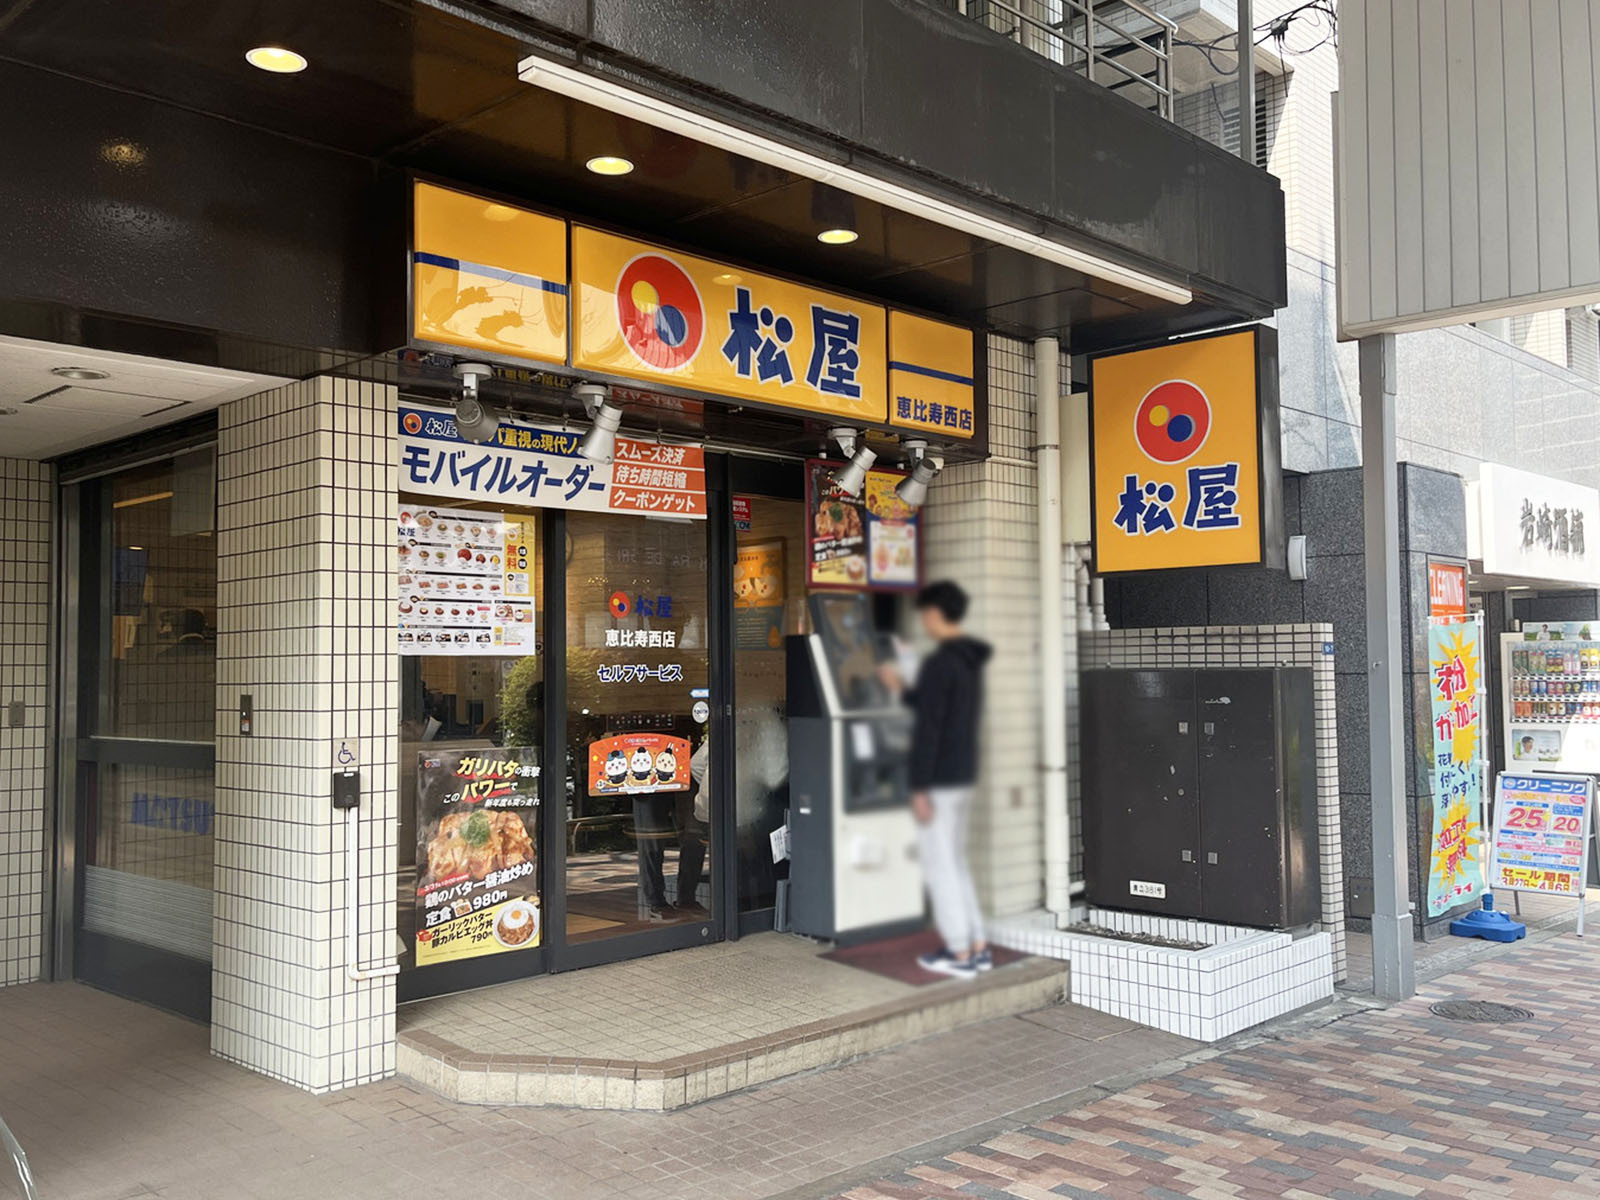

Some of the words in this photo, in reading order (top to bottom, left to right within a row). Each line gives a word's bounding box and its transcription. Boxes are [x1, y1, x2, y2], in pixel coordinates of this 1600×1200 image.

[722, 286, 863, 399] 松屋
[896, 397, 972, 431] 恵比寿西店
[425, 417, 458, 438] 松屋
[616, 442, 685, 465] スムーズ決済
[402, 445, 605, 500] モバイルオーダー
[616, 465, 687, 489] 待ち時間短縮
[613, 488, 695, 512] クーポンゲット
[1114, 463, 1241, 536] 松屋
[634, 594, 672, 618] 松屋
[605, 629, 676, 648] 恵比寿西店
[597, 664, 683, 682] セルフサービス
[443, 780, 518, 803] このパワーで
[1517, 780, 1586, 793] クリーニング
[1506, 808, 1544, 828] 25
[1553, 817, 1580, 831] 20
[1502, 868, 1570, 884] セール期間
[426, 906, 452, 927] 定食
[473, 890, 508, 910] 980円
[431, 912, 492, 938] ガーリックバター
[471, 931, 493, 944] 790円
